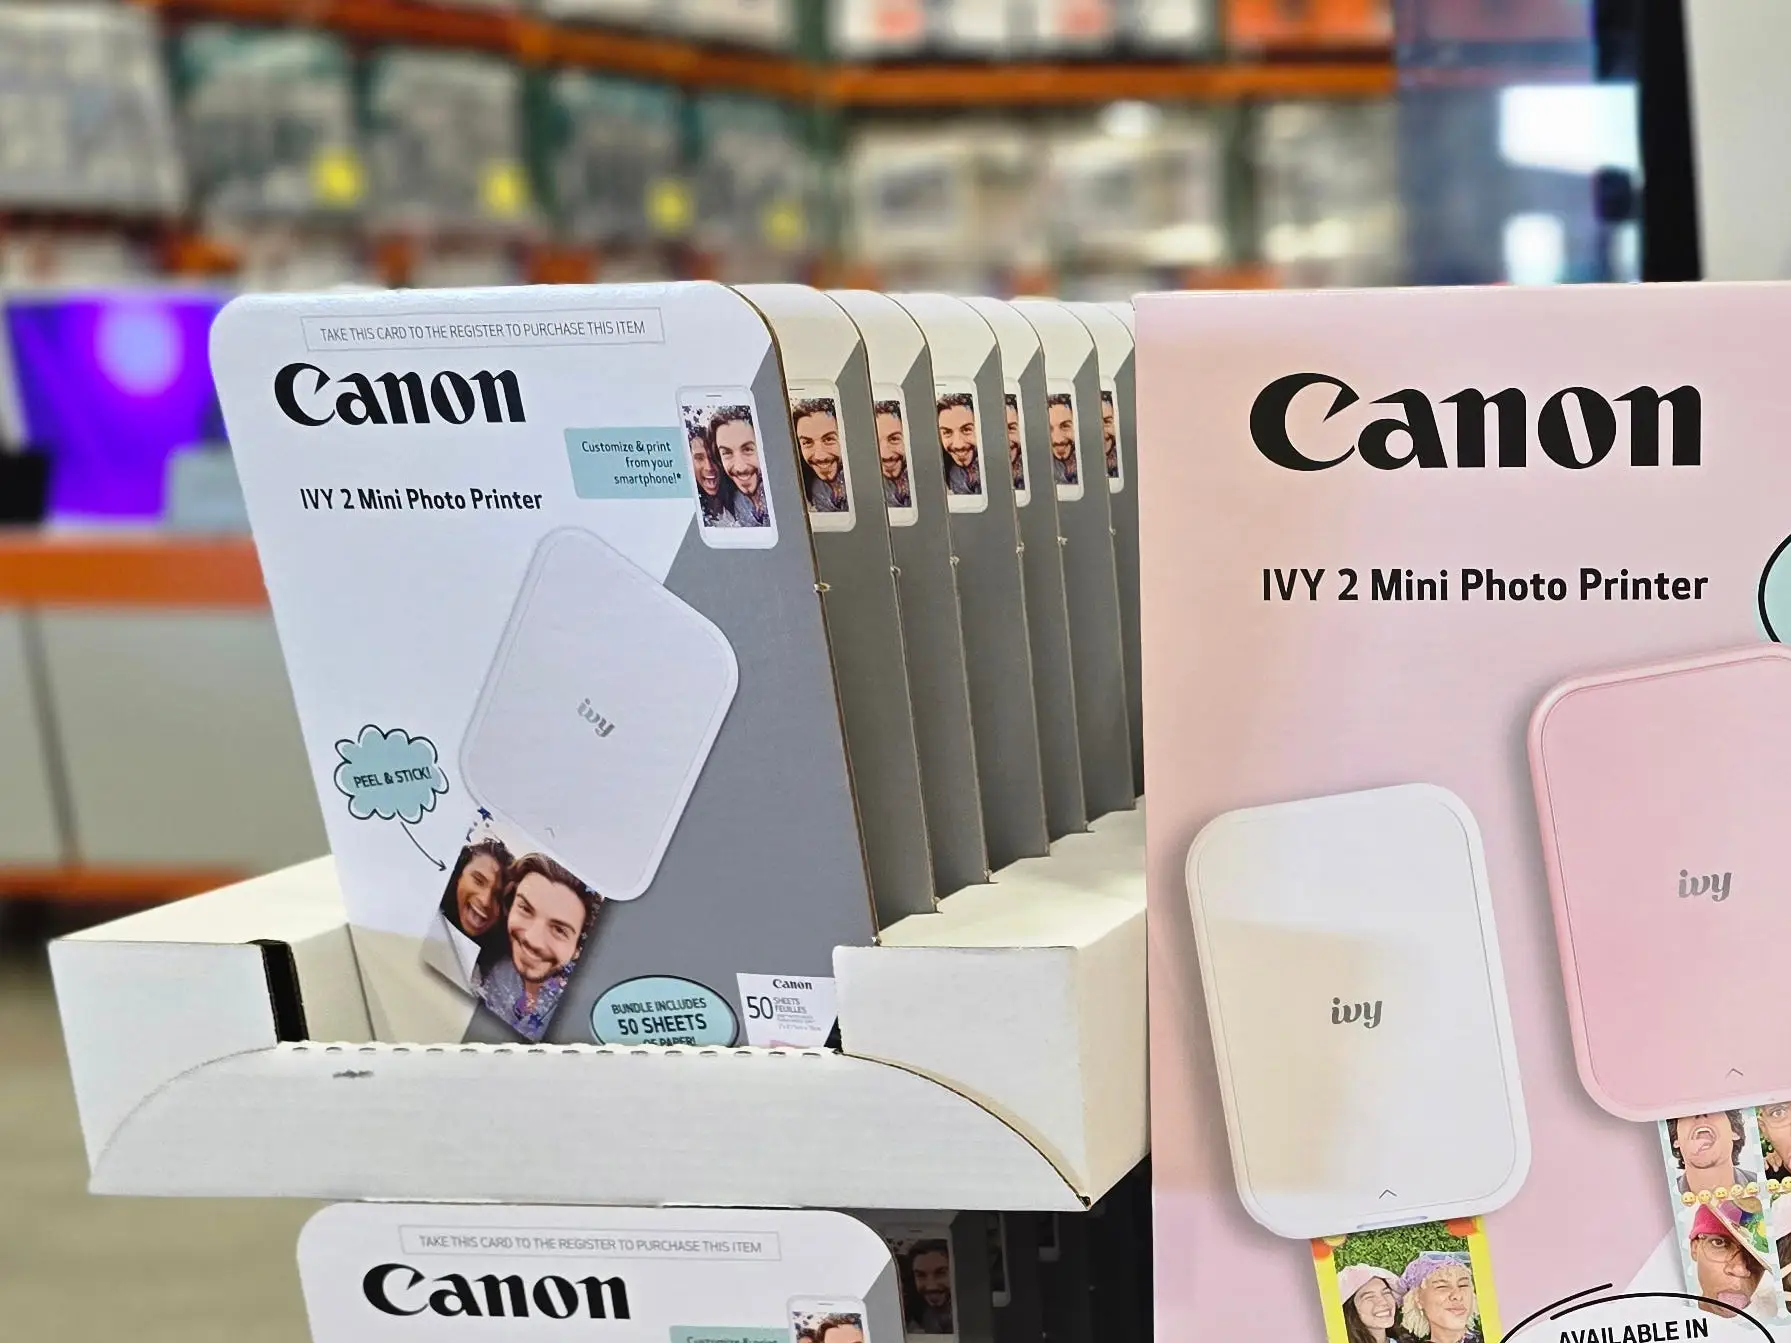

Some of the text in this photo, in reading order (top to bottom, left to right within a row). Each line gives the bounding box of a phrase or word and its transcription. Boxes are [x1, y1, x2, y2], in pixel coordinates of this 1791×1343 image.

[320, 321, 645, 341] TAKE THIS CARD TO THE REGISTER TO PURCHASE THIS ITEM
[275, 363, 526, 426] Canon
[1250, 373, 1701, 471] Canon
[582, 441, 671, 455] Customize & print
[626, 457, 673, 471] from your
[300, 488, 542, 509] IVY 2 Mini Photo Printer
[1264, 568, 1708, 601] IVY 2 Mini Photo Printer
[354, 767, 432, 788] PEEL & STICK!
[1679, 870, 1732, 902] ivy
[773, 979, 812, 990] Canon
[611, 998, 707, 1015] BUNDLE INCLUDES
[747, 996, 774, 1019] 50
[1332, 998, 1382, 1029] ivy
[618, 1014, 707, 1035] 50 SHEETS
[363, 1264, 630, 1319] Canon
[1686, 1318, 1708, 1339] IN
